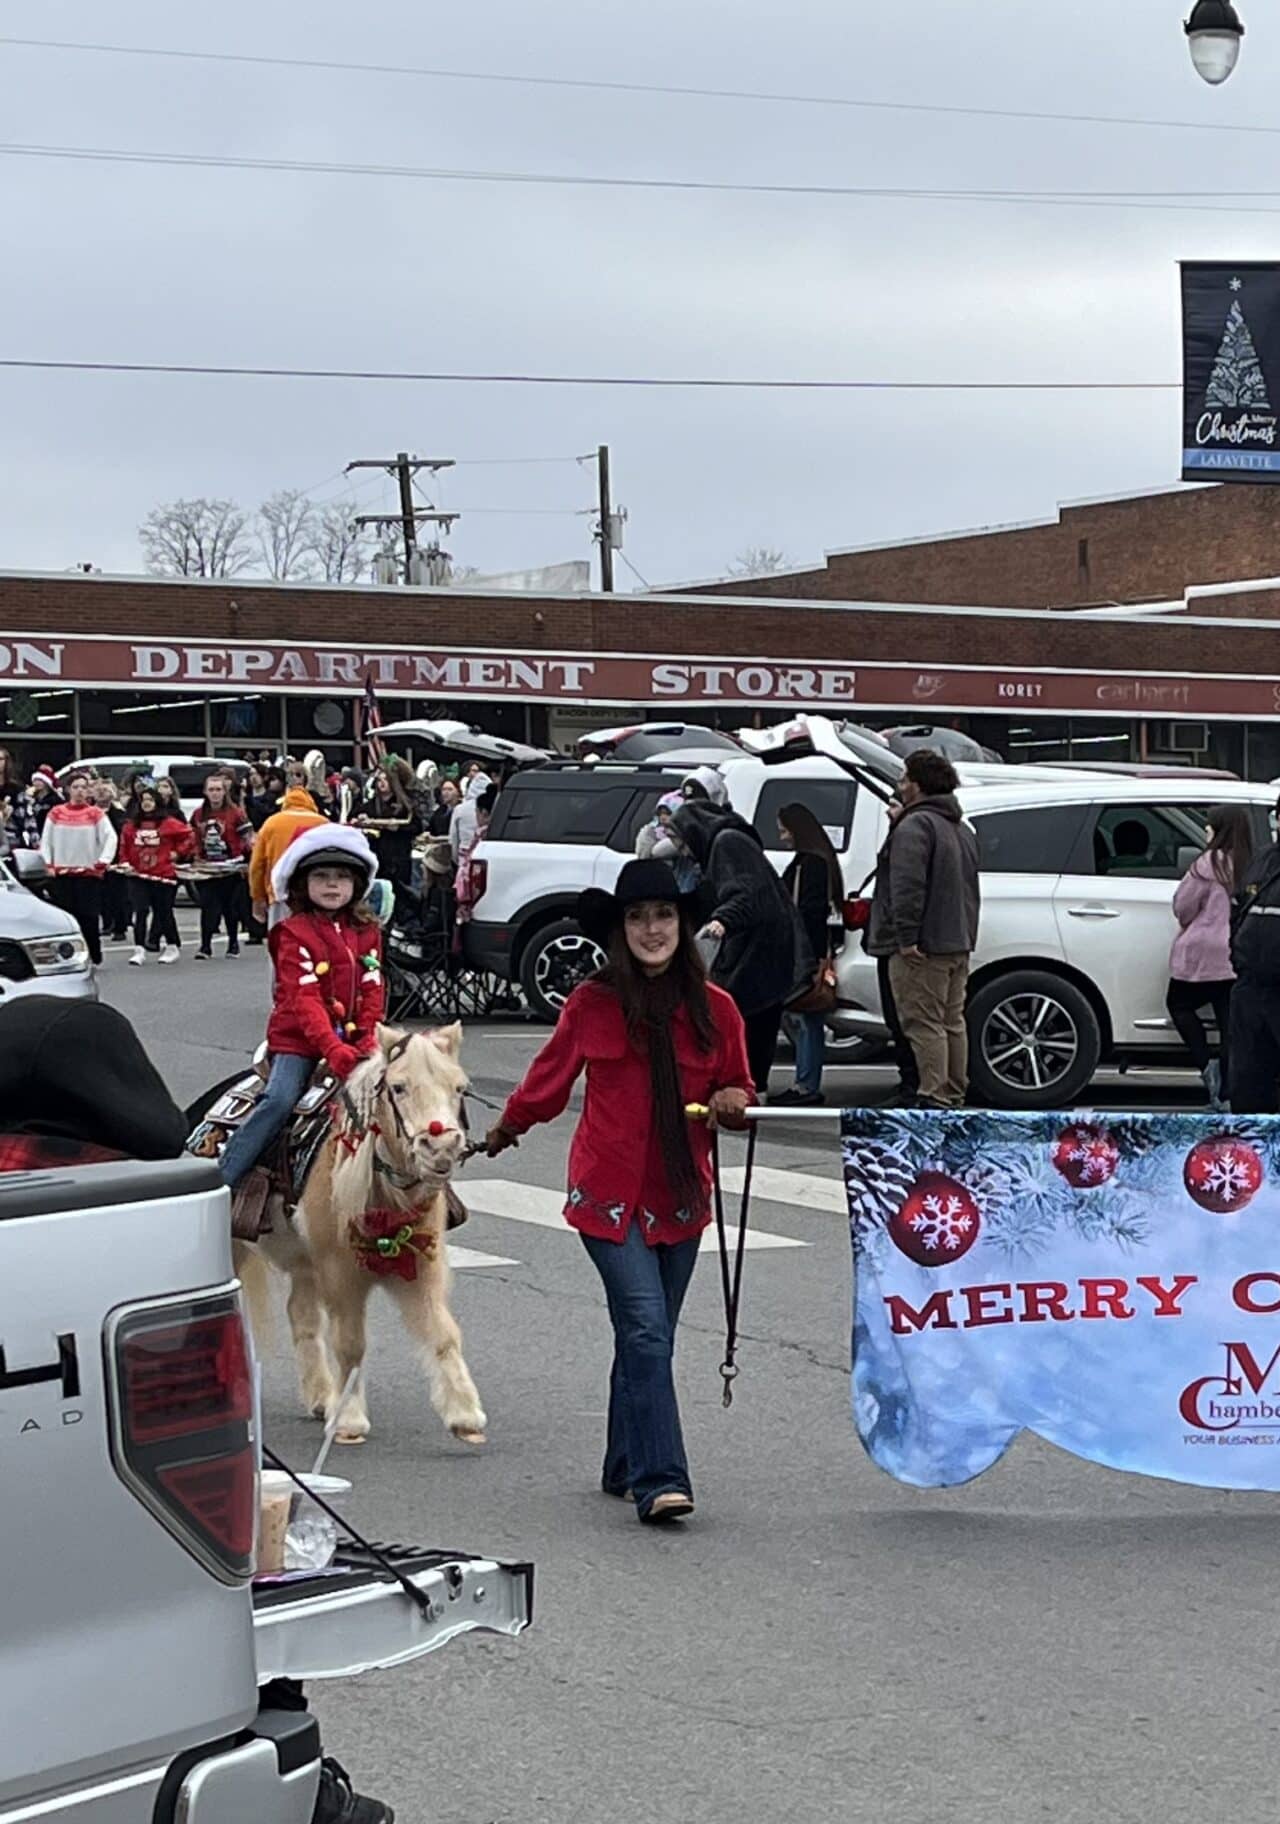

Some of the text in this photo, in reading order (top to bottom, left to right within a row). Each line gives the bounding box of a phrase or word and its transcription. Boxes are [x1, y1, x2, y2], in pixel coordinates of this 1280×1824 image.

[1195, 411, 1278, 445] Christmas
[1200, 453, 1273, 468] LAFAYETTE
[0, 643, 856, 699] N DEPARTMENT STORE
[998, 683, 1043, 697] KORET
[883, 1275, 1198, 1334] MERRY
[1183, 1434, 1216, 1446] YOUR
[1218, 1434, 1275, 1446] BUSINESS
